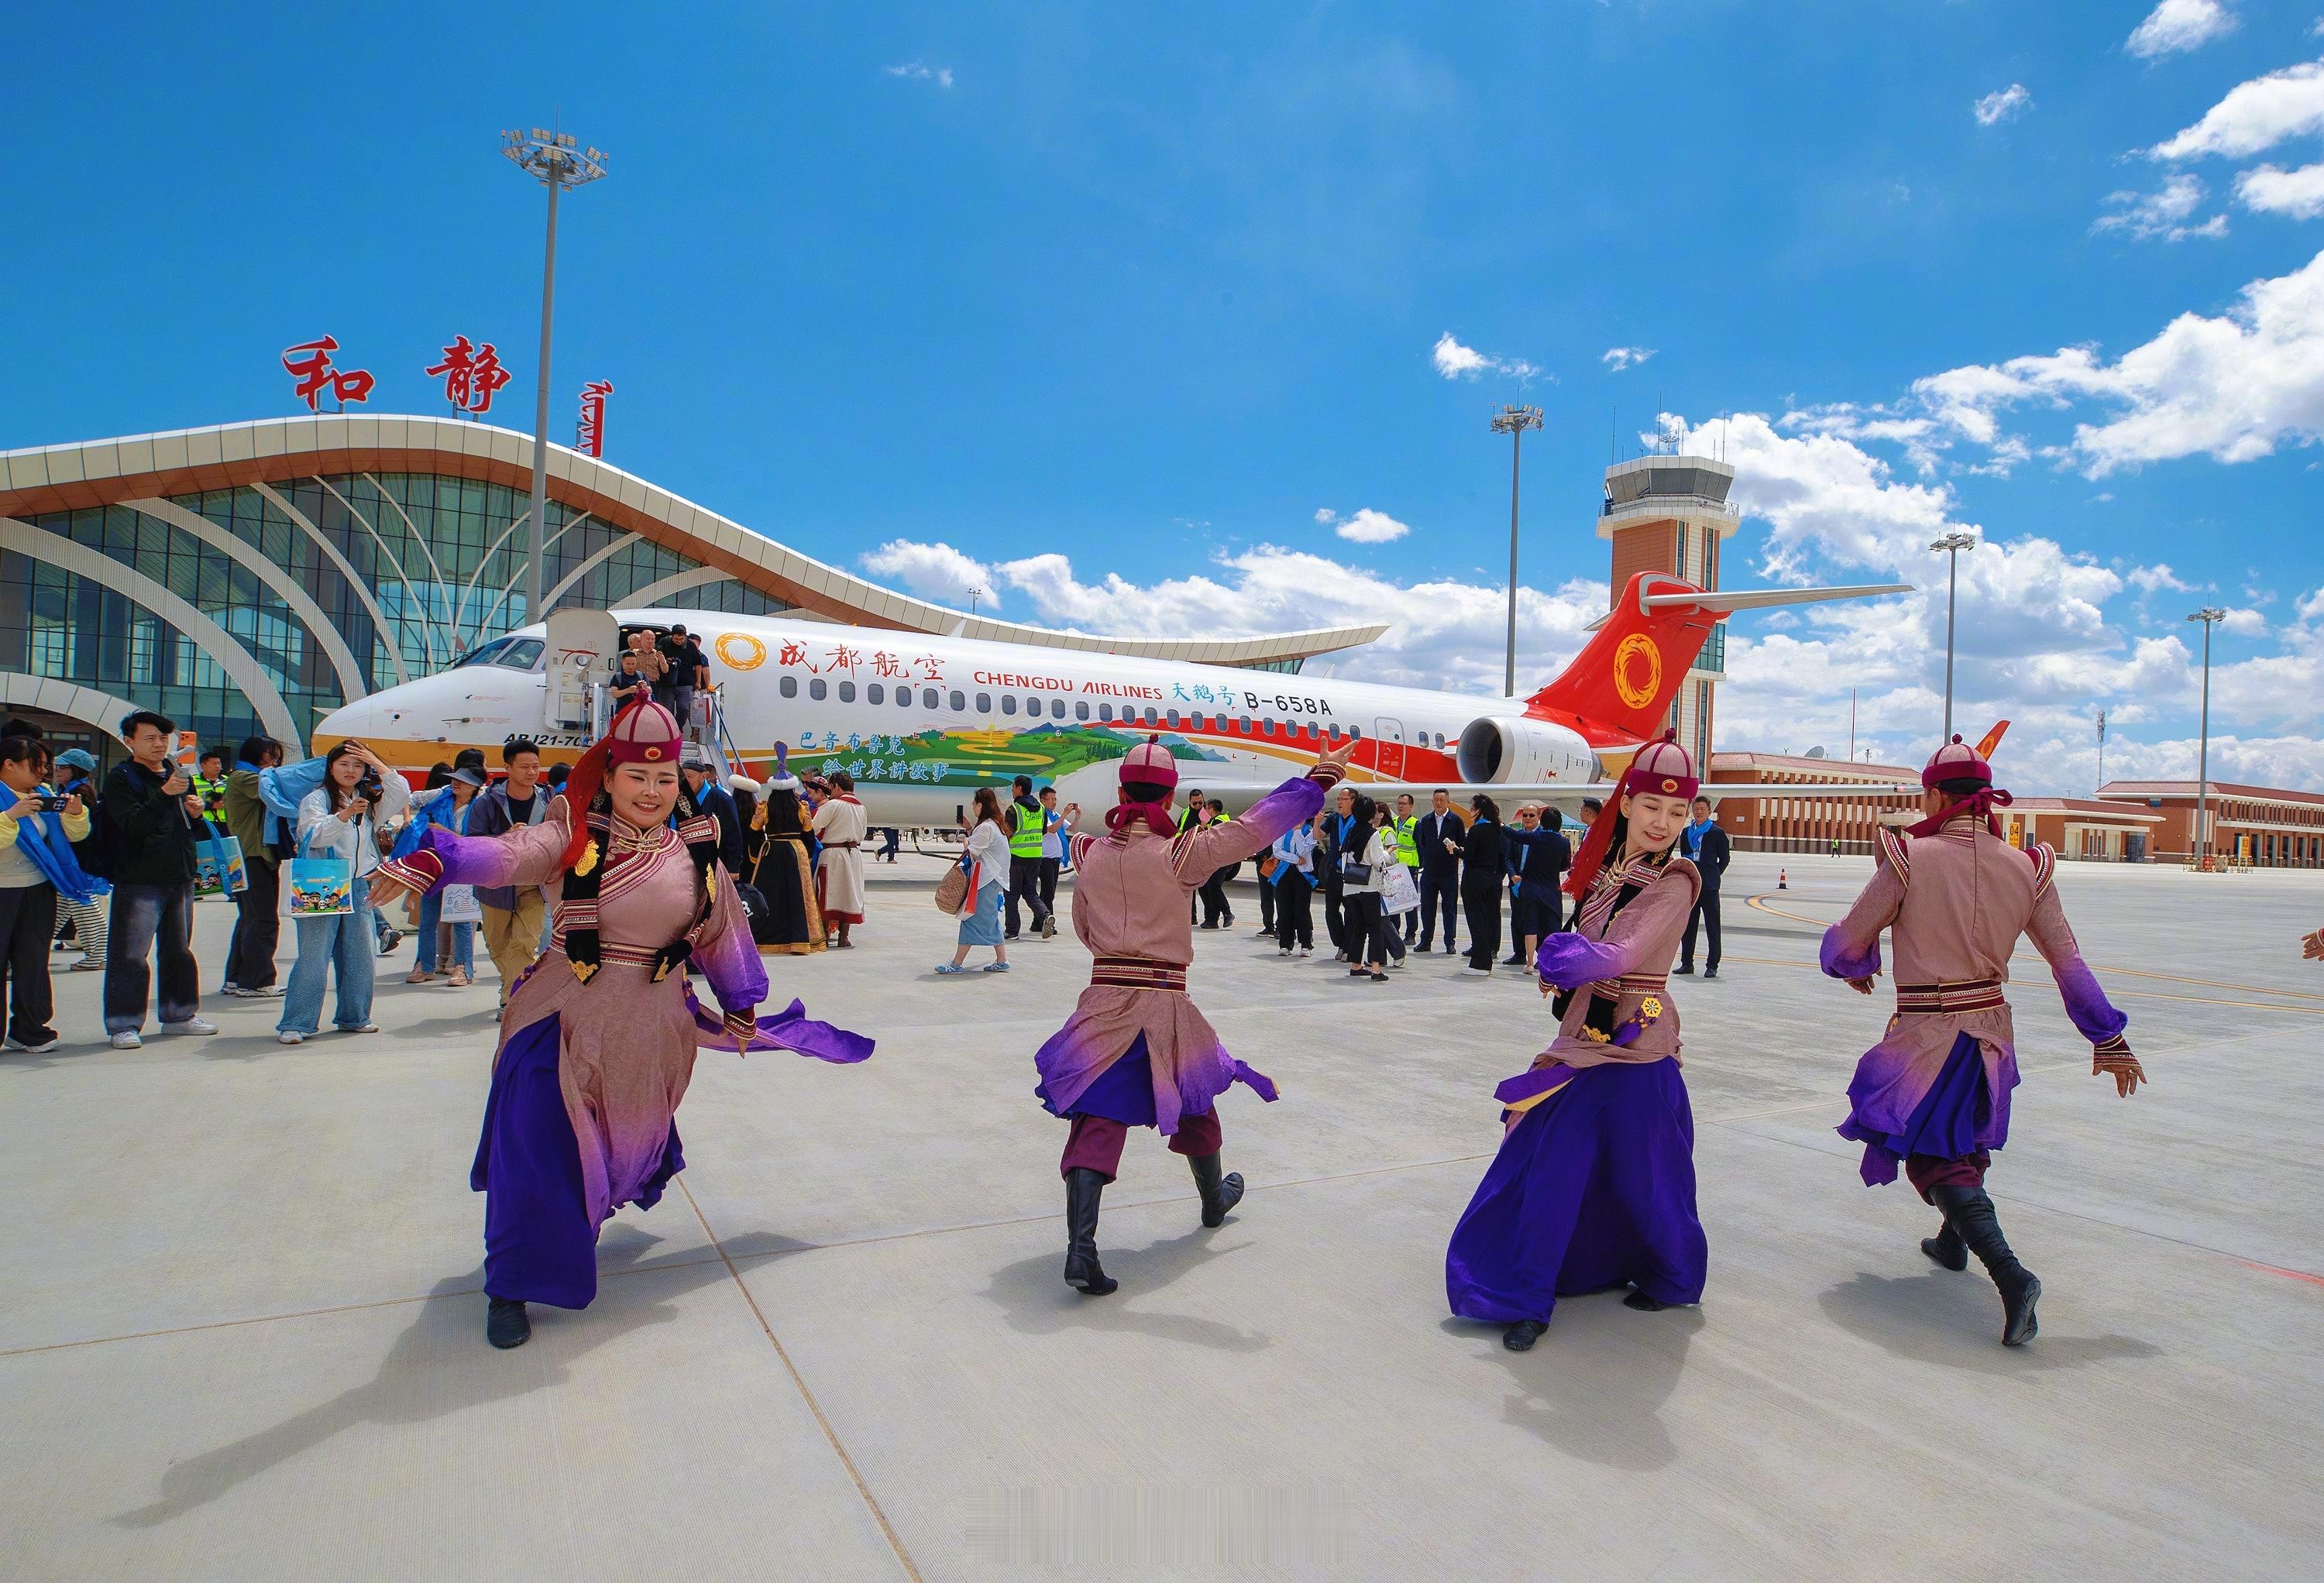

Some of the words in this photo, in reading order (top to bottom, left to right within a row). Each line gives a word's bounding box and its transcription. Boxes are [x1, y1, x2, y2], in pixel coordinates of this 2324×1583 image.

[281, 335, 511, 413] 和静
[779, 637, 945, 680] 成都航空
[974, 671, 1074, 692] CHENGDU
[1081, 682, 1163, 700] AIRLINES
[1171, 682, 1236, 706] 天鹅号
[1244, 692, 1332, 716] B-658A
[799, 731, 905, 756] 巴音布鲁克
[822, 758, 949, 782] 给世界讲故事
[2009, 826, 2019, 836] 04
